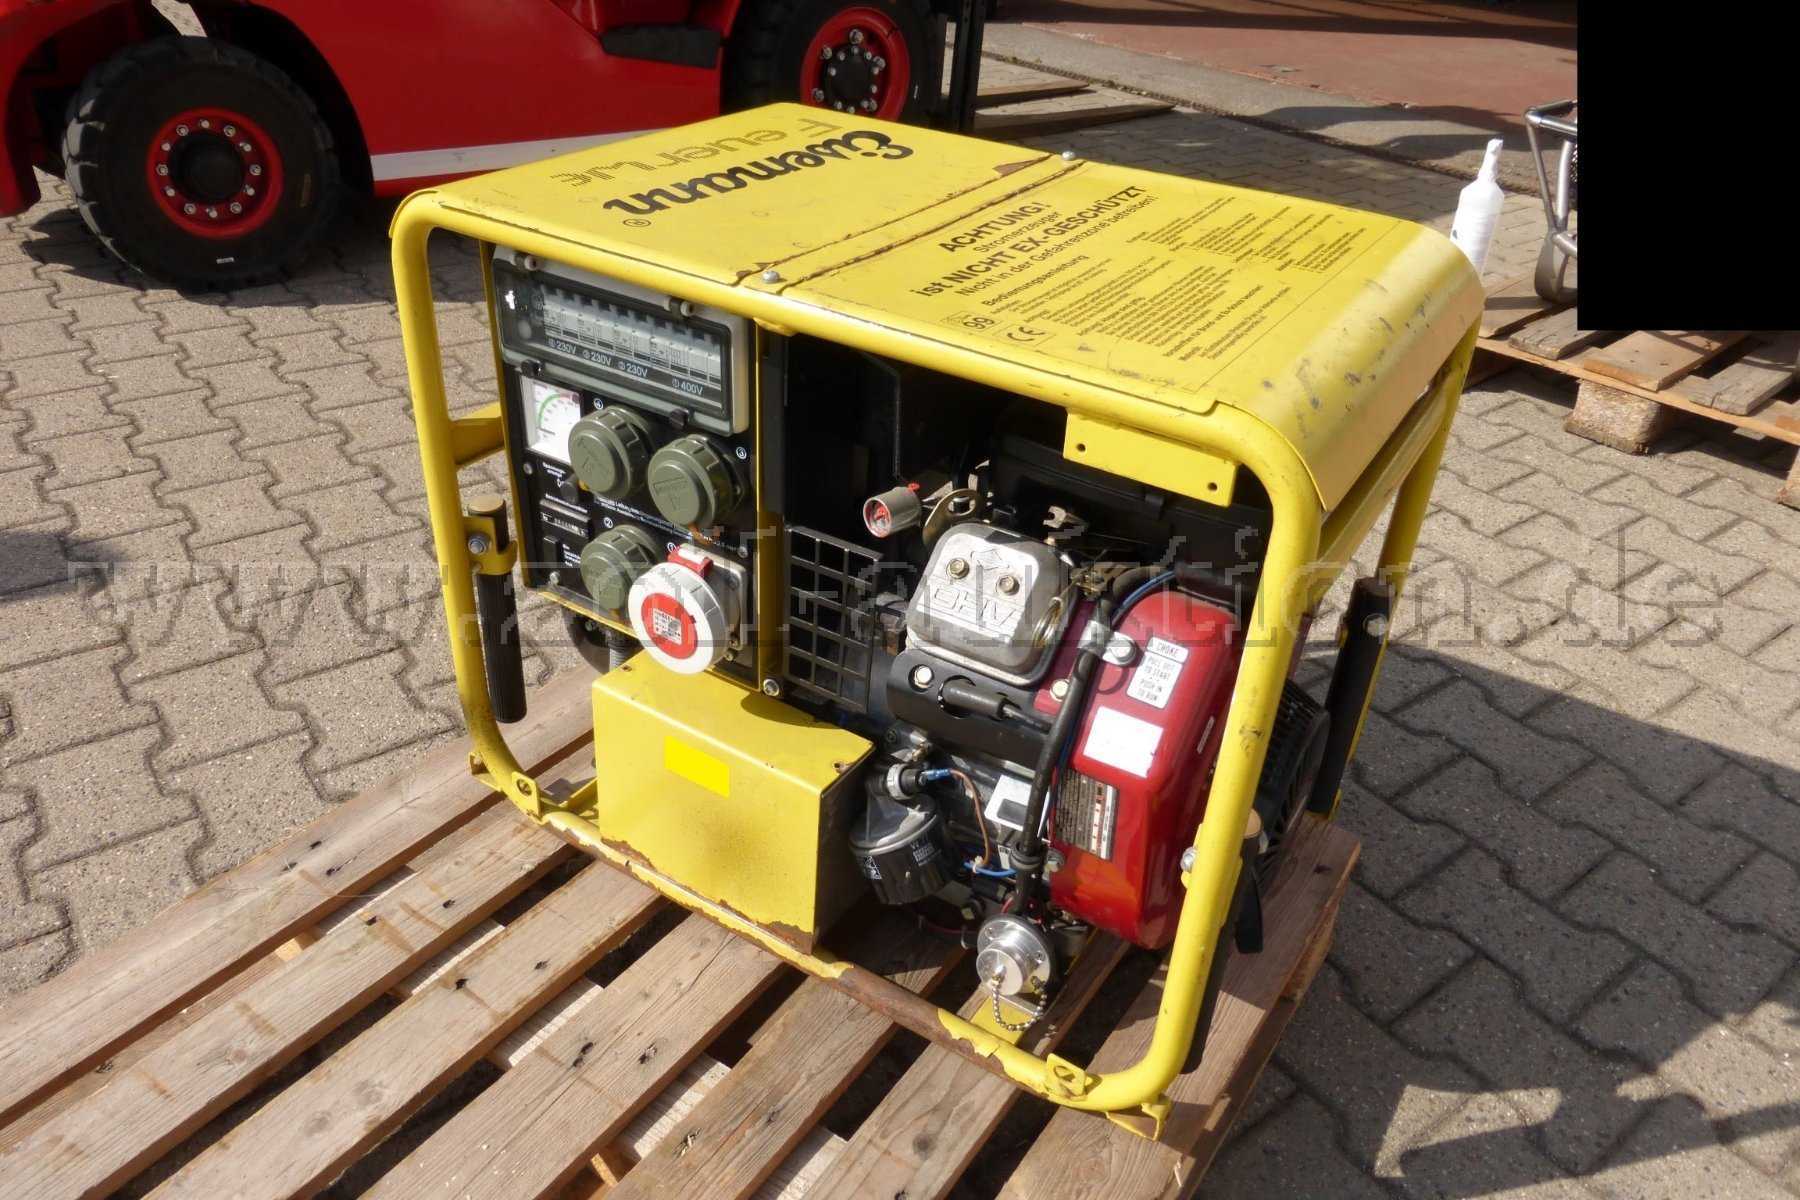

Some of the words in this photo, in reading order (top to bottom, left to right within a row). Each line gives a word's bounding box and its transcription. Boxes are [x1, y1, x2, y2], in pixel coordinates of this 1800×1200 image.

[603, 130, 914, 215] Eisemann
[911, 277, 953, 297] ist
[942, 250, 1017, 286] NICHT
[1008, 185, 1147, 254] EX-GESCHÜTZT
[938, 202, 1052, 253] ACHTUNG!
[973, 211, 1063, 254] Stromerzeuger
[955, 274, 996, 297] Nicht
[998, 270, 1012, 283] in
[1010, 260, 1034, 275] der
[1030, 221, 1111, 262] Gefahrenzone
[590, 350, 612, 366] 230V
[626, 362, 648, 378] 230V
[680, 380, 704, 396] 400V
